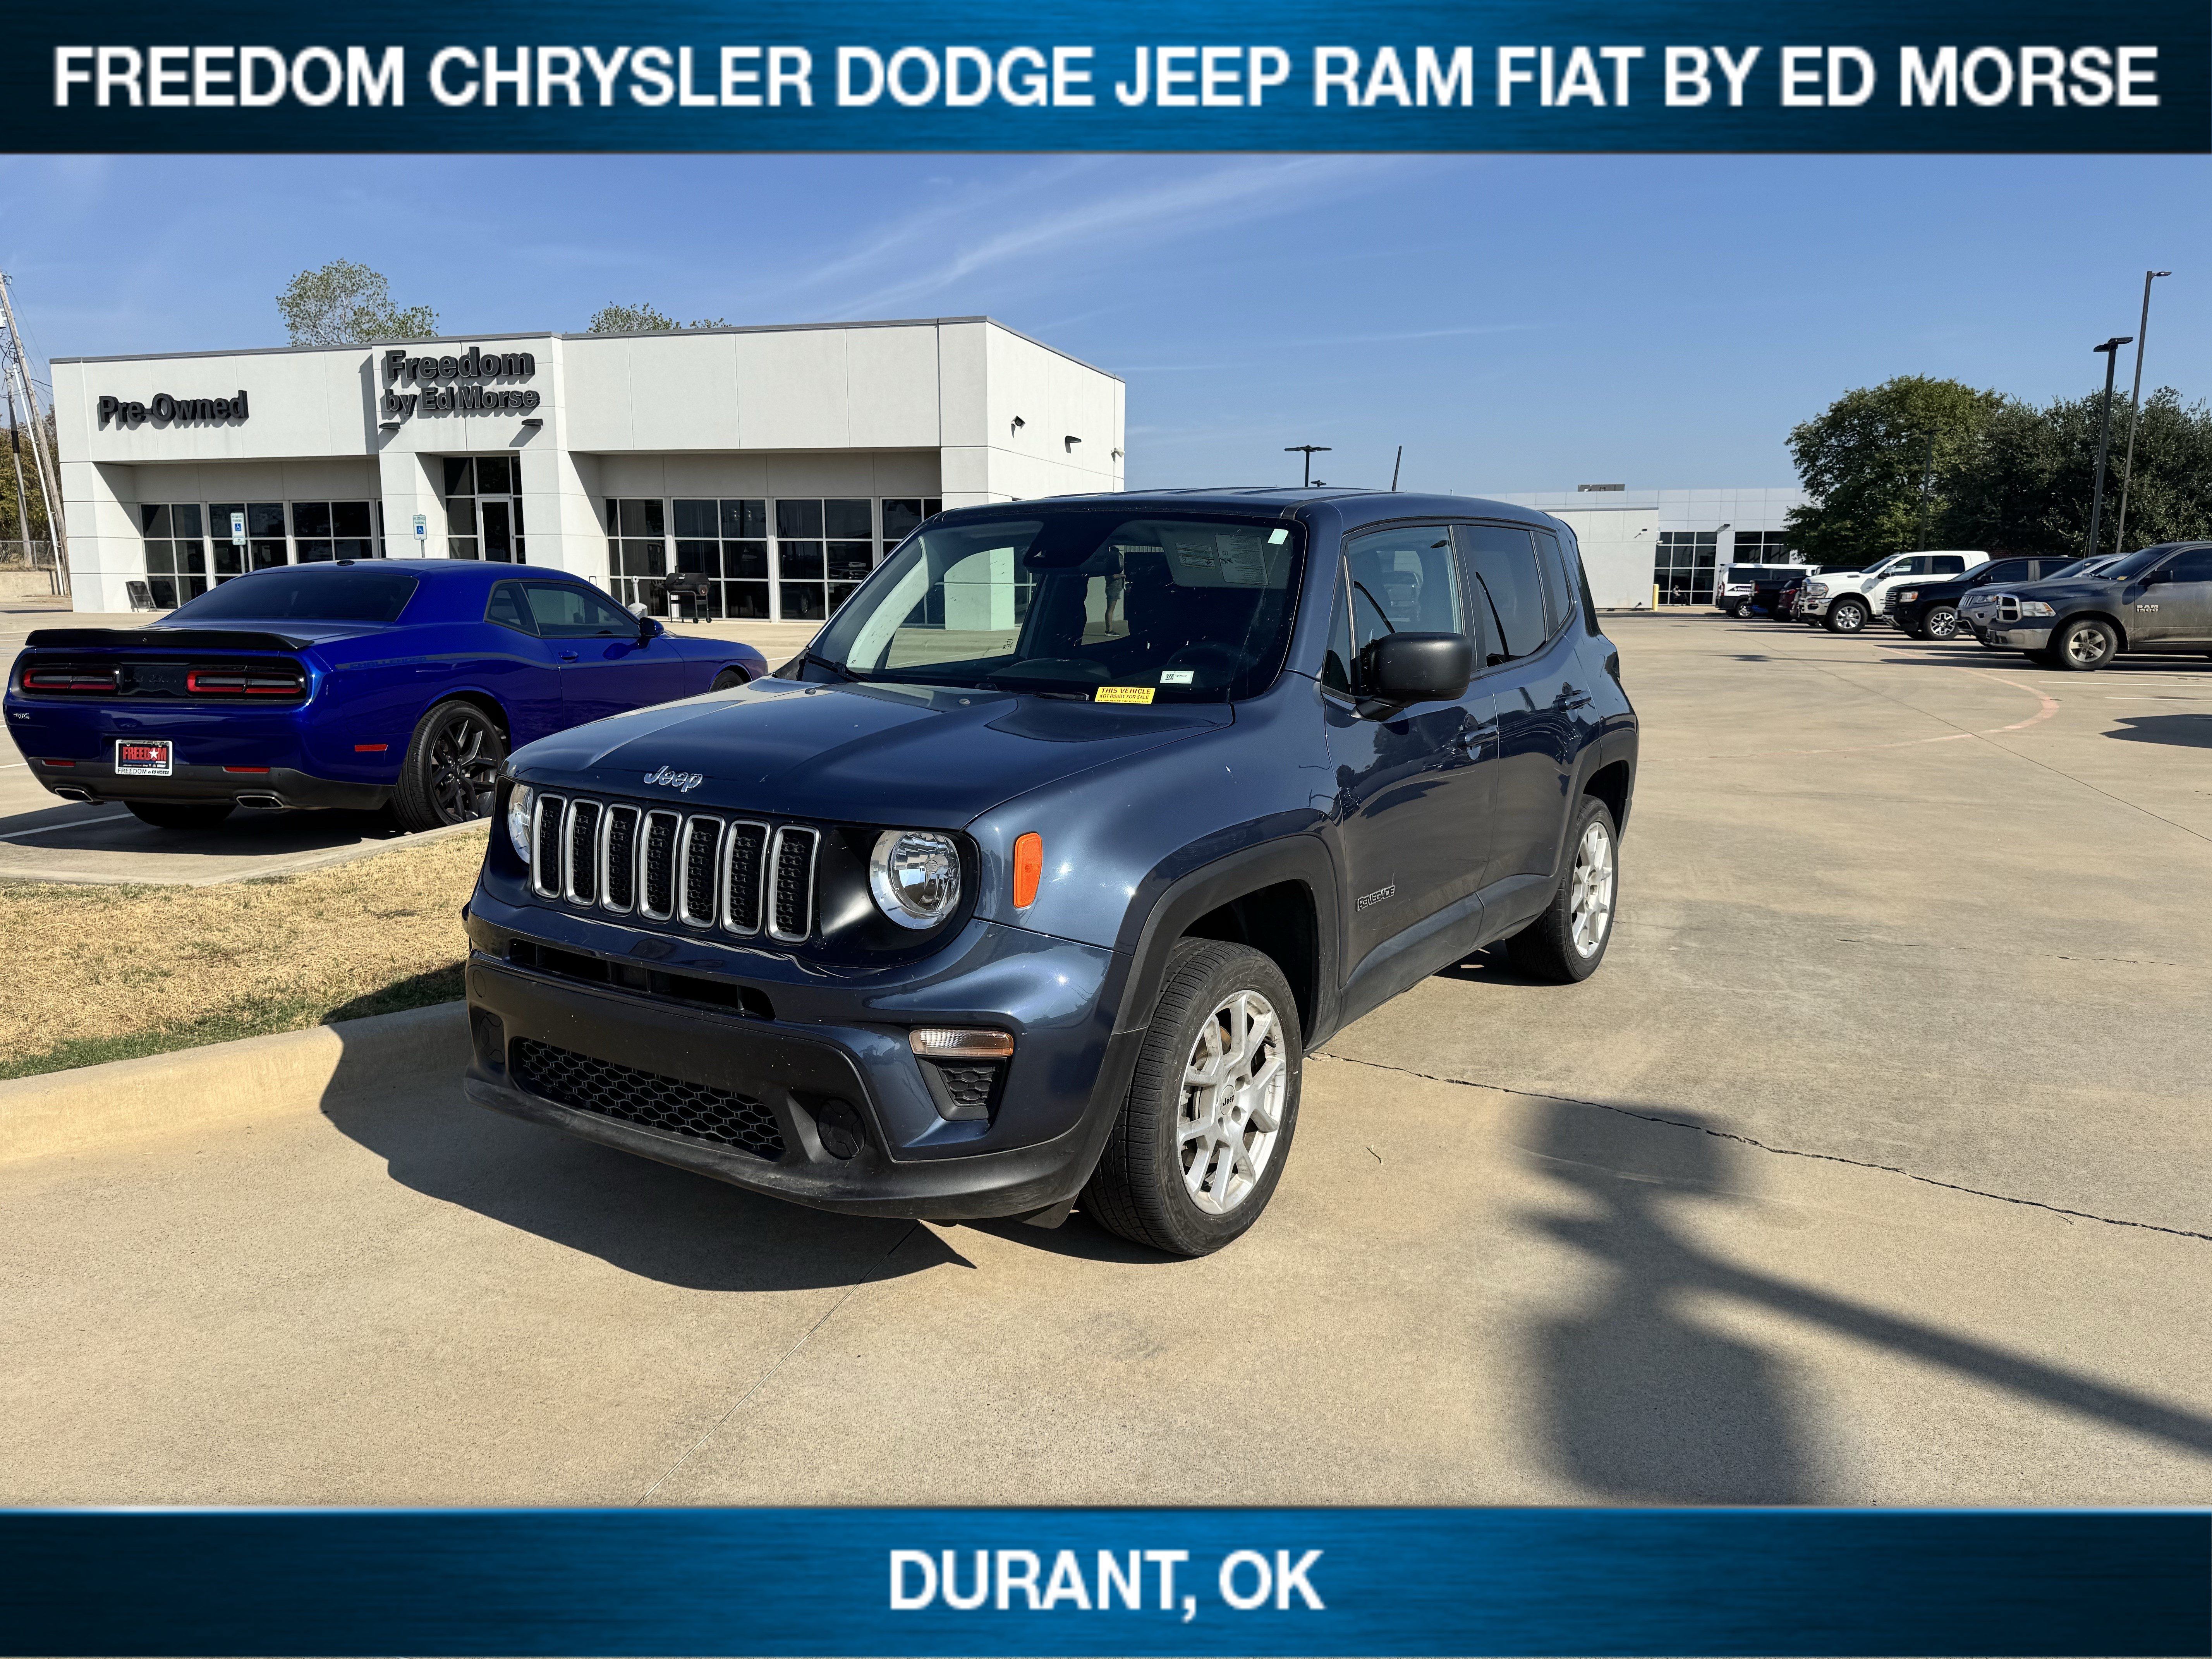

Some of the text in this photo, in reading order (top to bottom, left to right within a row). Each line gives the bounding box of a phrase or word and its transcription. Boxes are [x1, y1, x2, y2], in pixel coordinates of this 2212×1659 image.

[385, 346, 536, 380] Freedom
[99, 390, 249, 423] Pre-Owned
[384, 385, 540, 416] by Ed Morse
[644, 765, 702, 793] Jeep
[1356, 885, 1395, 912] RENEGADE
[1223, 1095, 1234, 1106] Jeep
